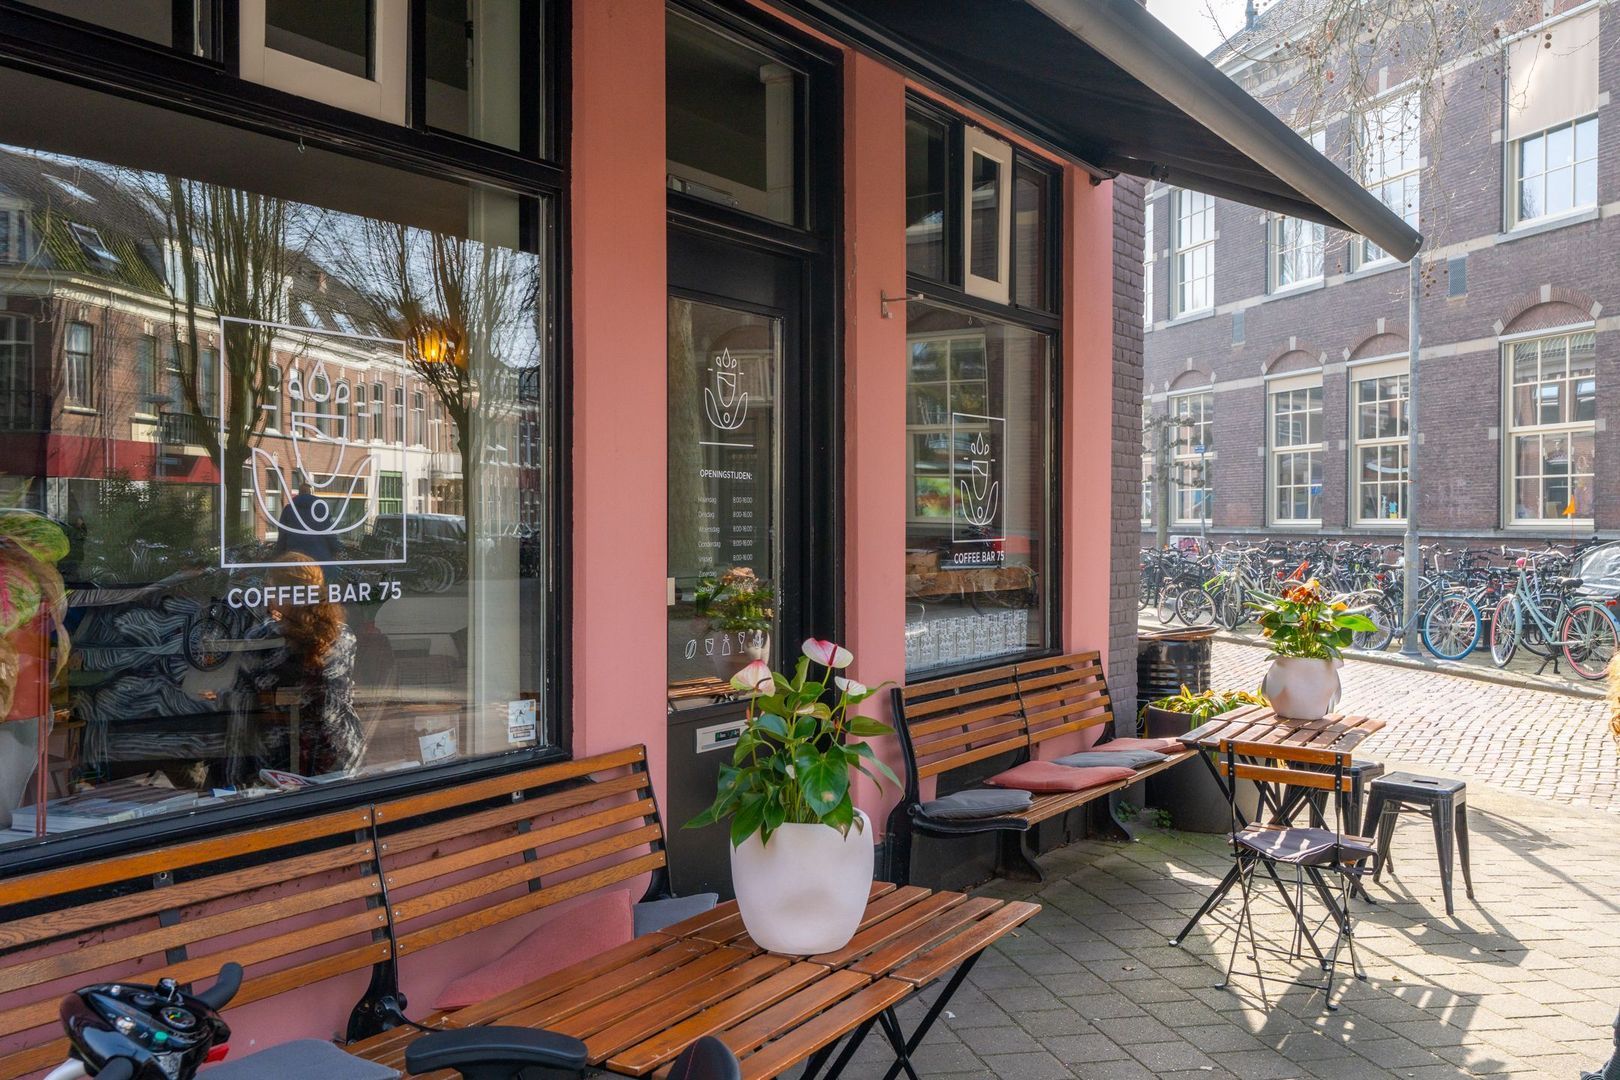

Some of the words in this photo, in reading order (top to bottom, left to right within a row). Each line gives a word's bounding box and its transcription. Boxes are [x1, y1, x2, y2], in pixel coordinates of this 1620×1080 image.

[699, 469, 753, 480] OPENINGSTIJDEN:
[953, 551, 981, 564] COFFEE
[981, 551, 996, 562] BAR
[996, 550, 1005, 561] 75
[227, 584, 320, 609] COFFEE
[328, 583, 371, 603] BAR
[379, 581, 402, 600] 75
